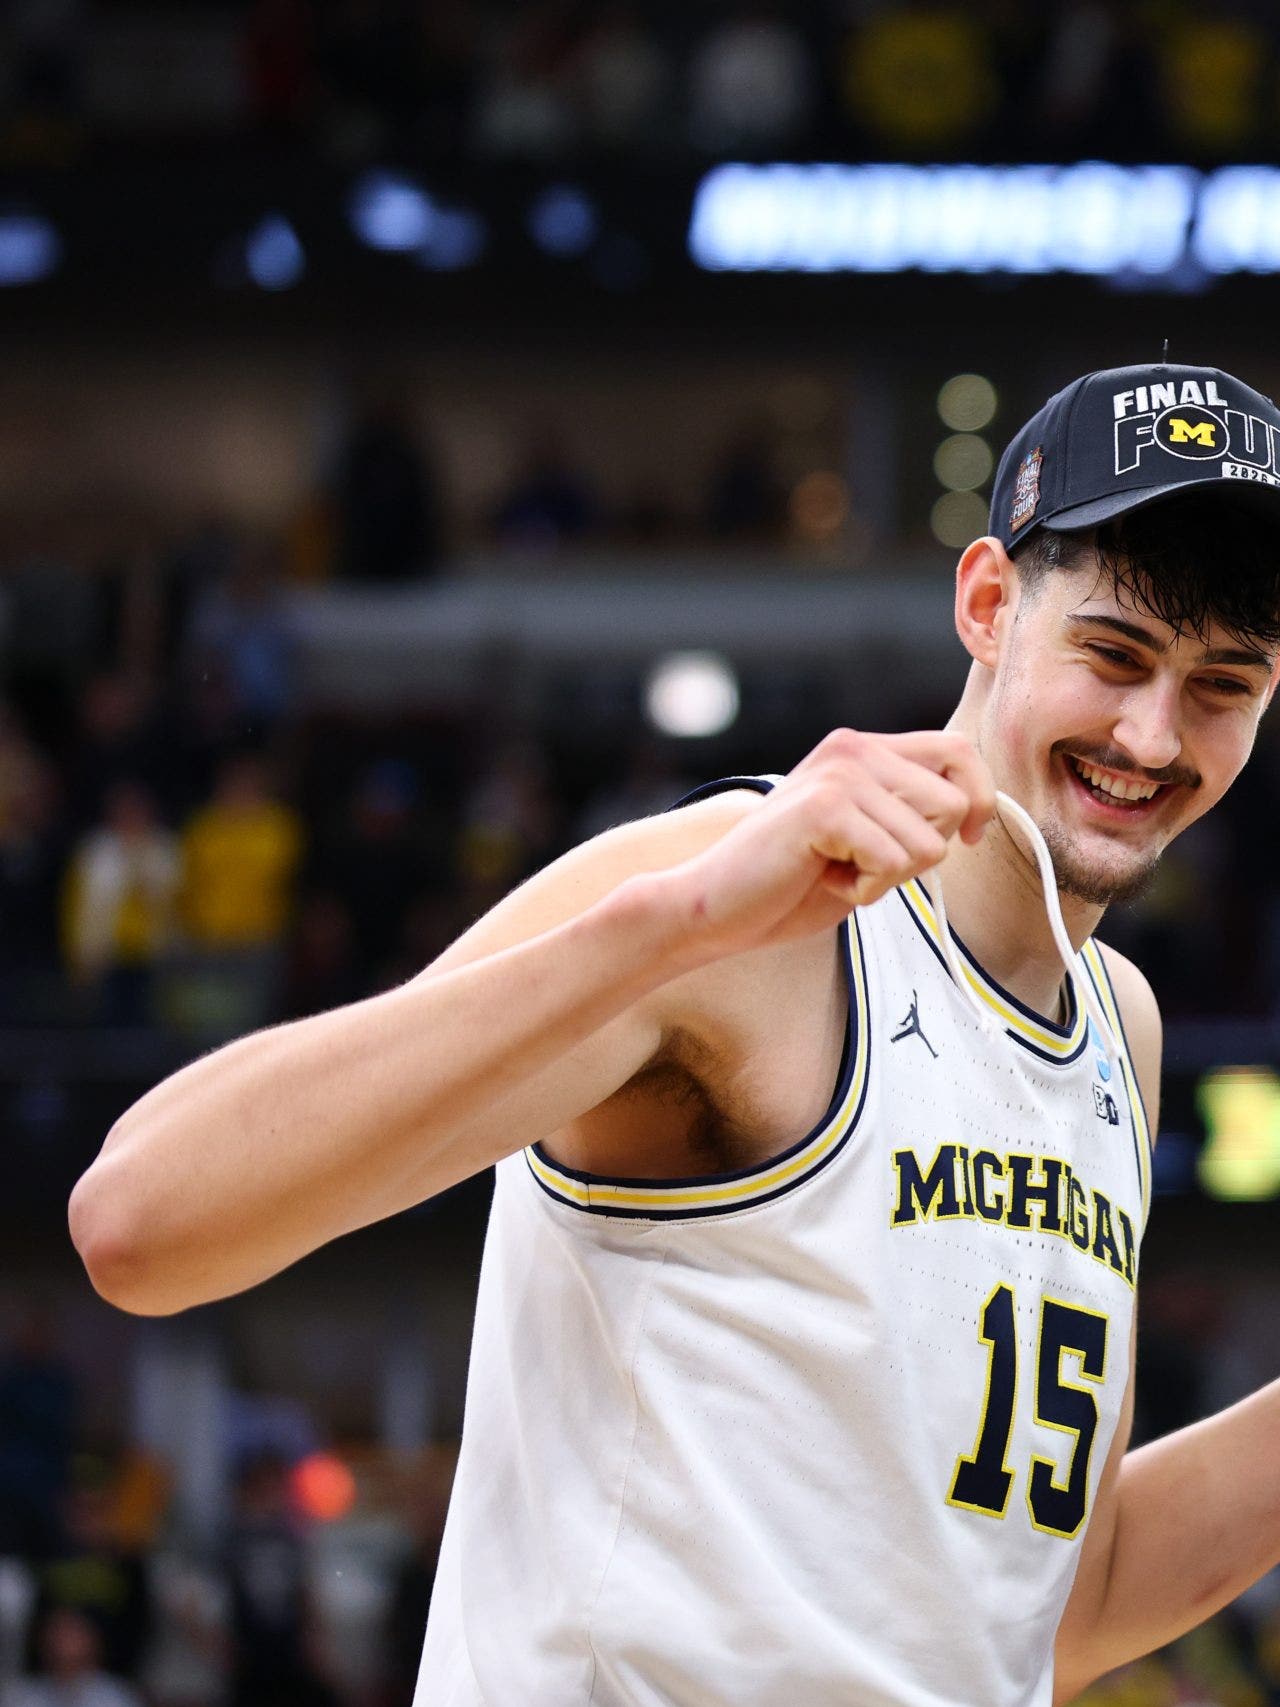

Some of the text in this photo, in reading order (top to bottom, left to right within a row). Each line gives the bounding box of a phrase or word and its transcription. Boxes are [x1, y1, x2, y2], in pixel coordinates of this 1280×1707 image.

[1113, 381, 1228, 419] FINAL
[1168, 418, 1216, 448] M
[945, 1281, 1110, 1540] 15
